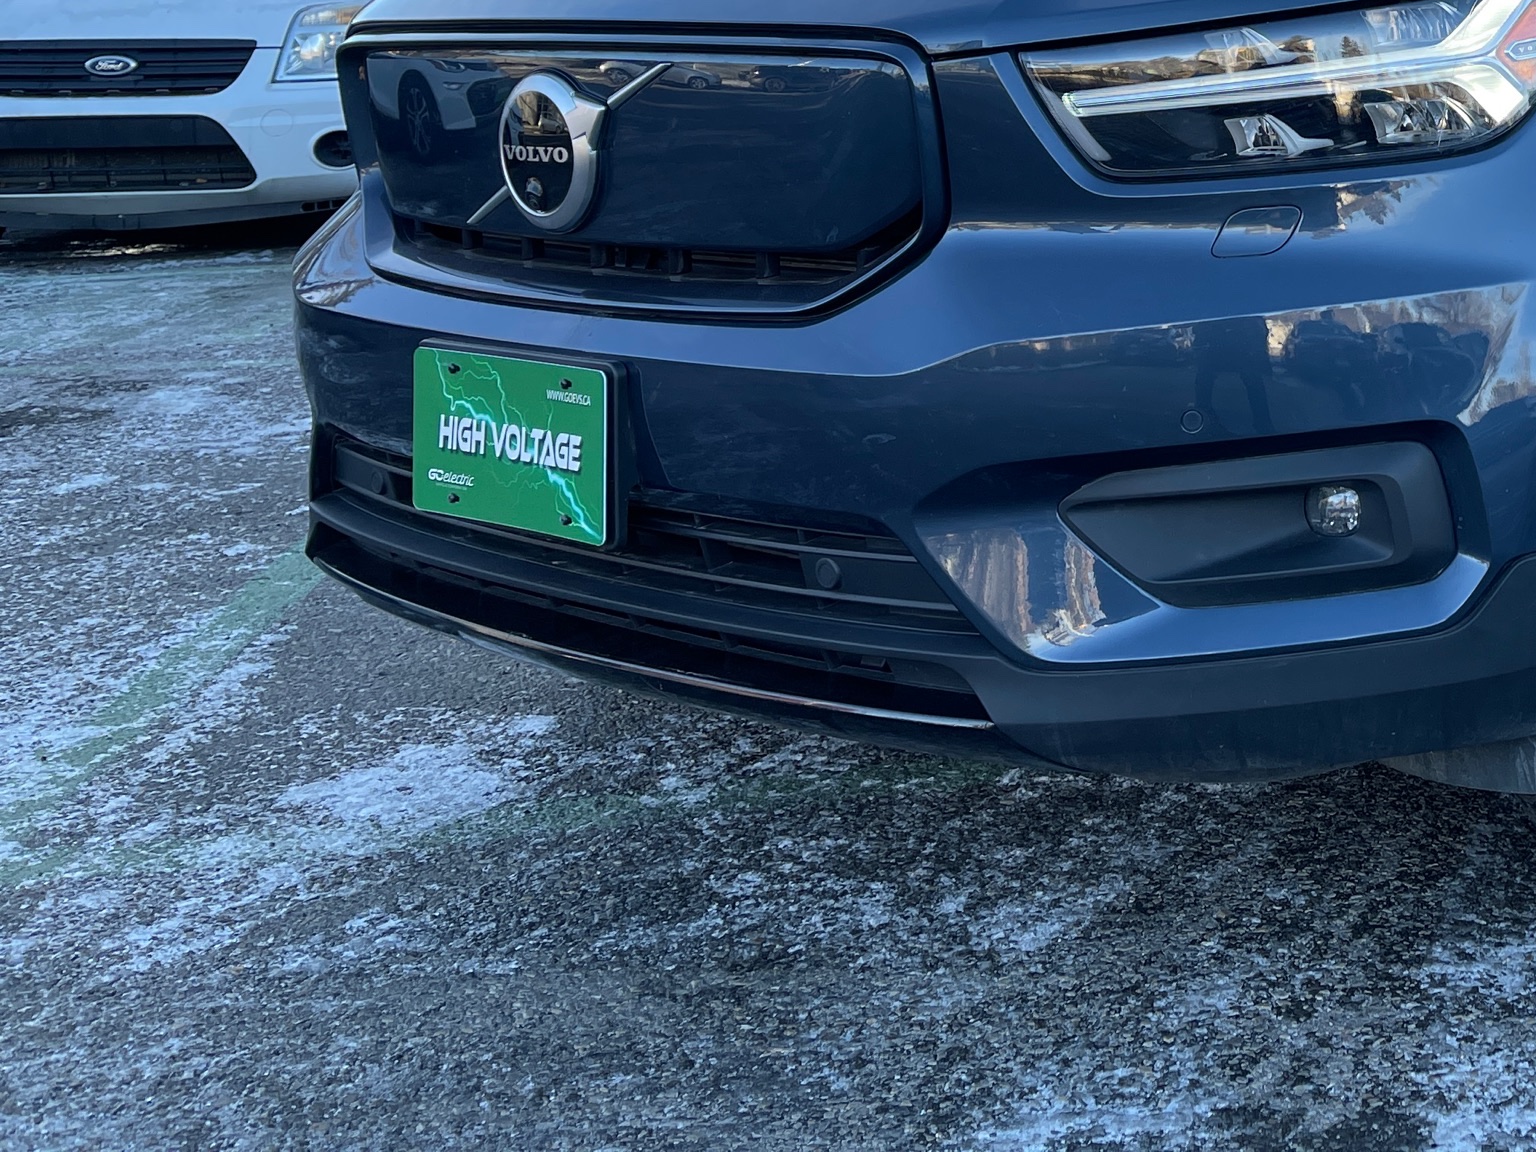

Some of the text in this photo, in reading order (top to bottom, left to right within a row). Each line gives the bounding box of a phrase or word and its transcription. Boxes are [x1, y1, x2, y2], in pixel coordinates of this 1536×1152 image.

[95, 60, 124, 71] Ford
[503, 144, 569, 163] VOLVO
[438, 414, 582, 472] HIGH VOLTAGE
